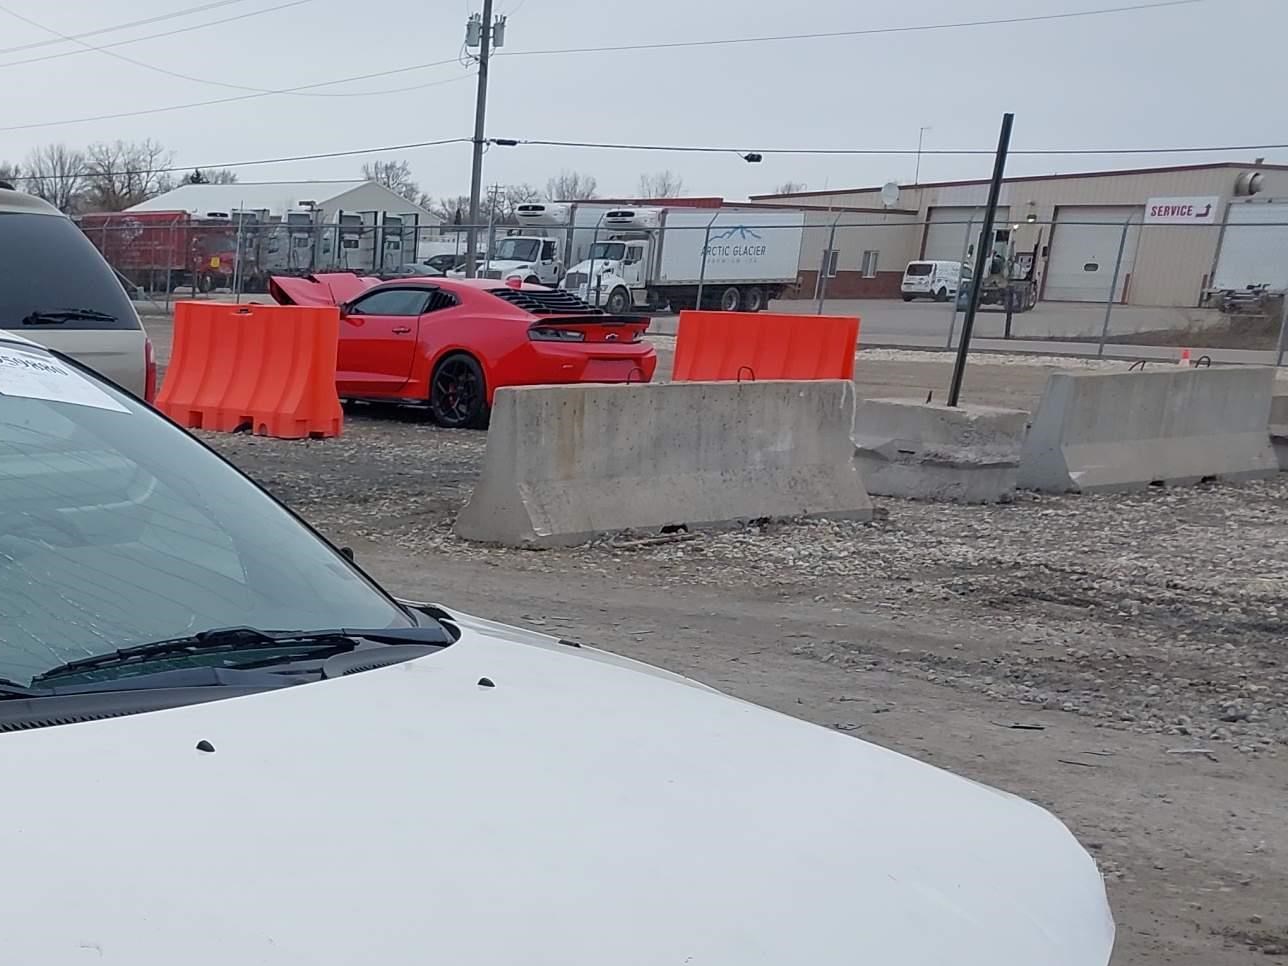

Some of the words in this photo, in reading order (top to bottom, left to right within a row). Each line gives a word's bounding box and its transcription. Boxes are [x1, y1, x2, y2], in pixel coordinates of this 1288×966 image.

[1150, 204, 1193, 218] SERVICE
[700, 245, 731, 257] ARCTIC
[732, 245, 767, 257] GLACIER
